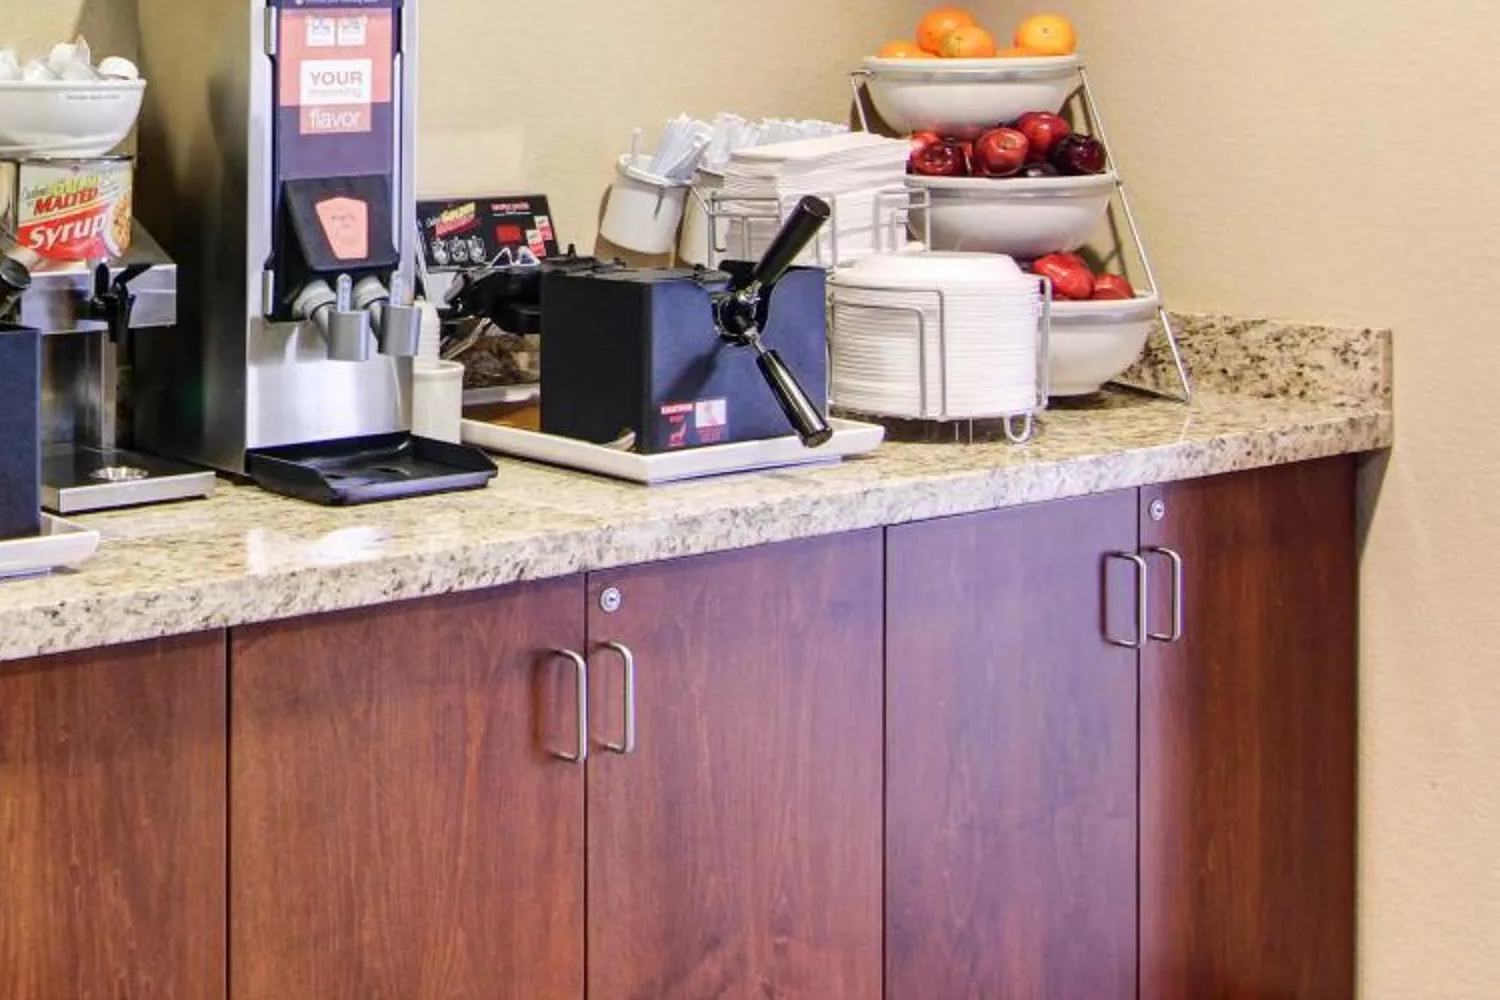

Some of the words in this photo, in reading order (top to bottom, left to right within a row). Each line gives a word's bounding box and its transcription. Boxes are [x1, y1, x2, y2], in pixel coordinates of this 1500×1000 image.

[310, 71, 363, 85] YOUR
[309, 108, 362, 130] flavor
[33, 186, 100, 216] MALTED
[28, 214, 107, 251] Syrup
